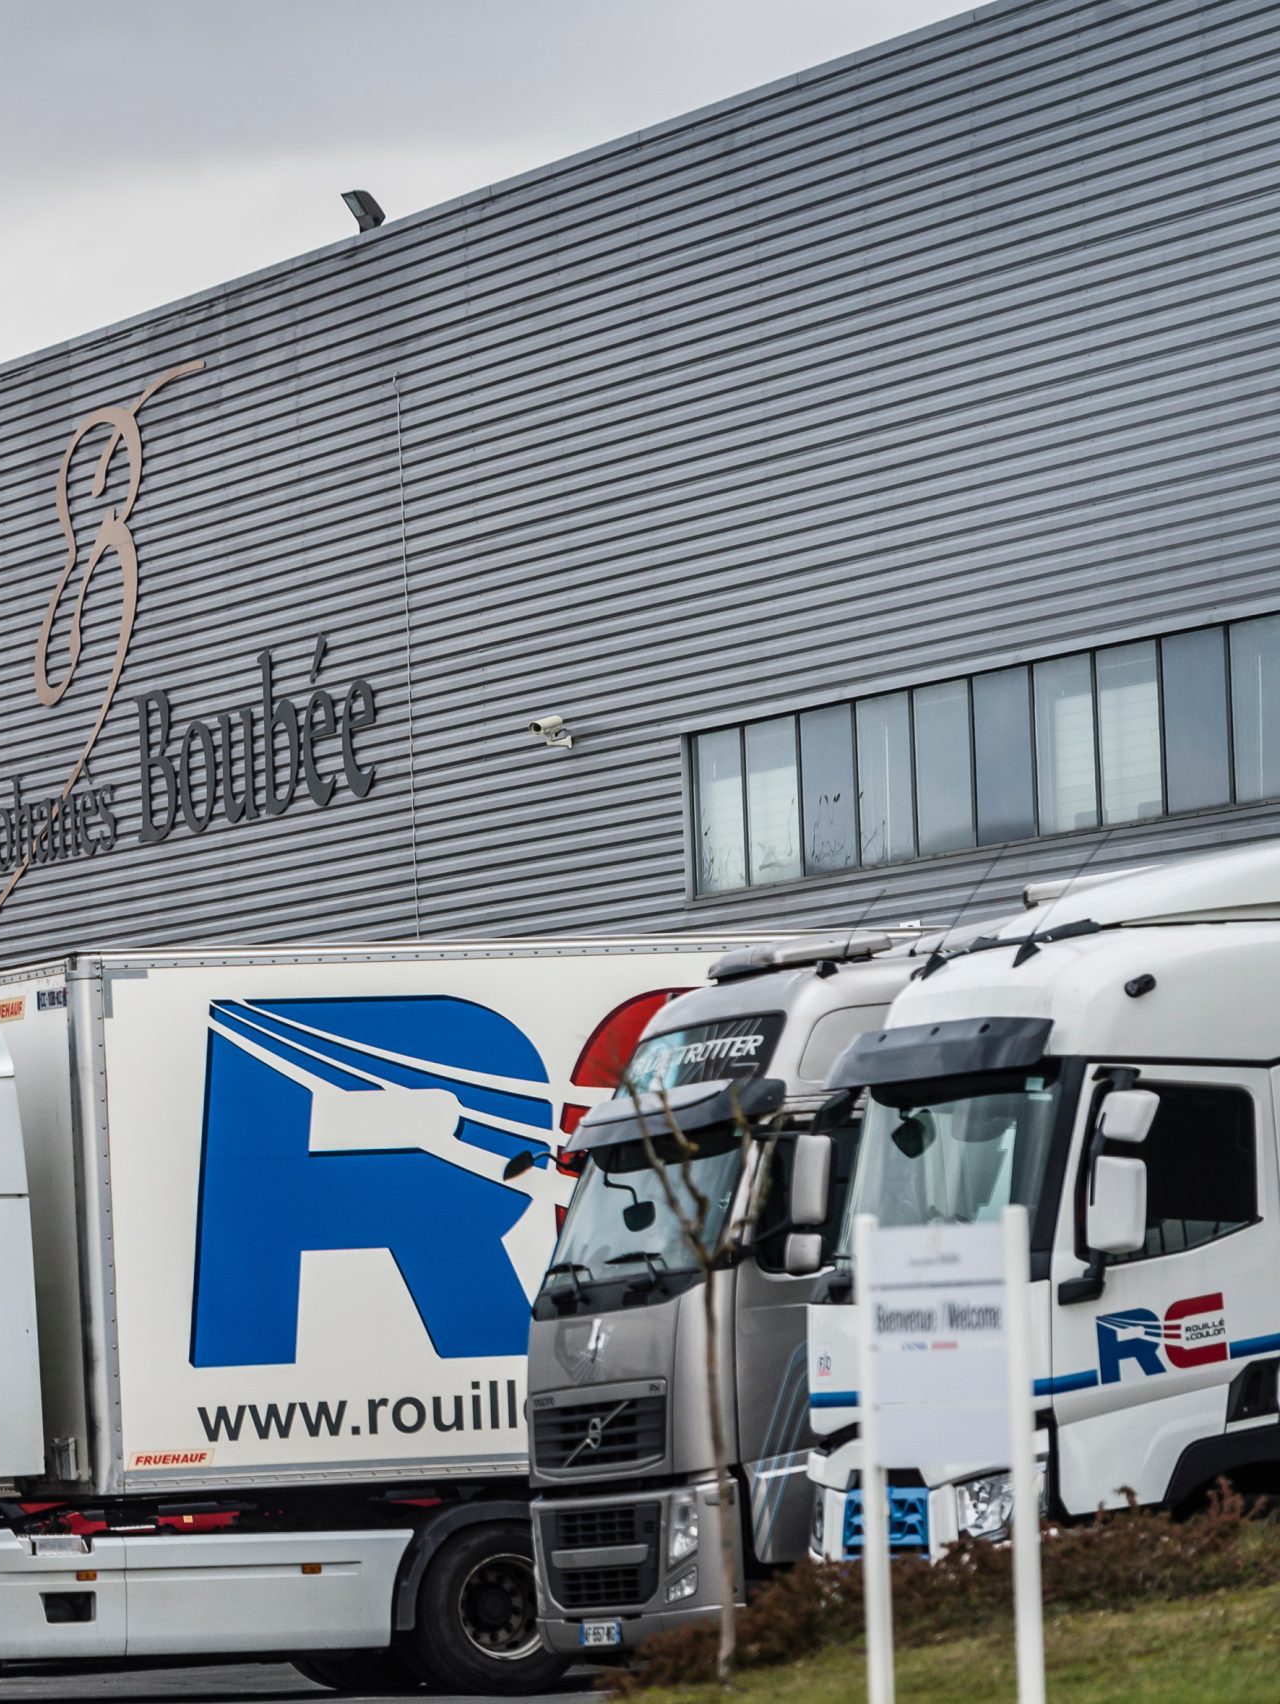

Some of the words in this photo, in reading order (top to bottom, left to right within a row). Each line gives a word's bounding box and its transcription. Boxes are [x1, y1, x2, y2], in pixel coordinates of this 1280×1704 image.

[133, 630, 377, 843] Boubée
[1185, 1318, 1225, 1333] ROUILLÉ
[196, 1378, 529, 1443] www.rouill
[134, 1452, 208, 1466] FRUEHAUF
